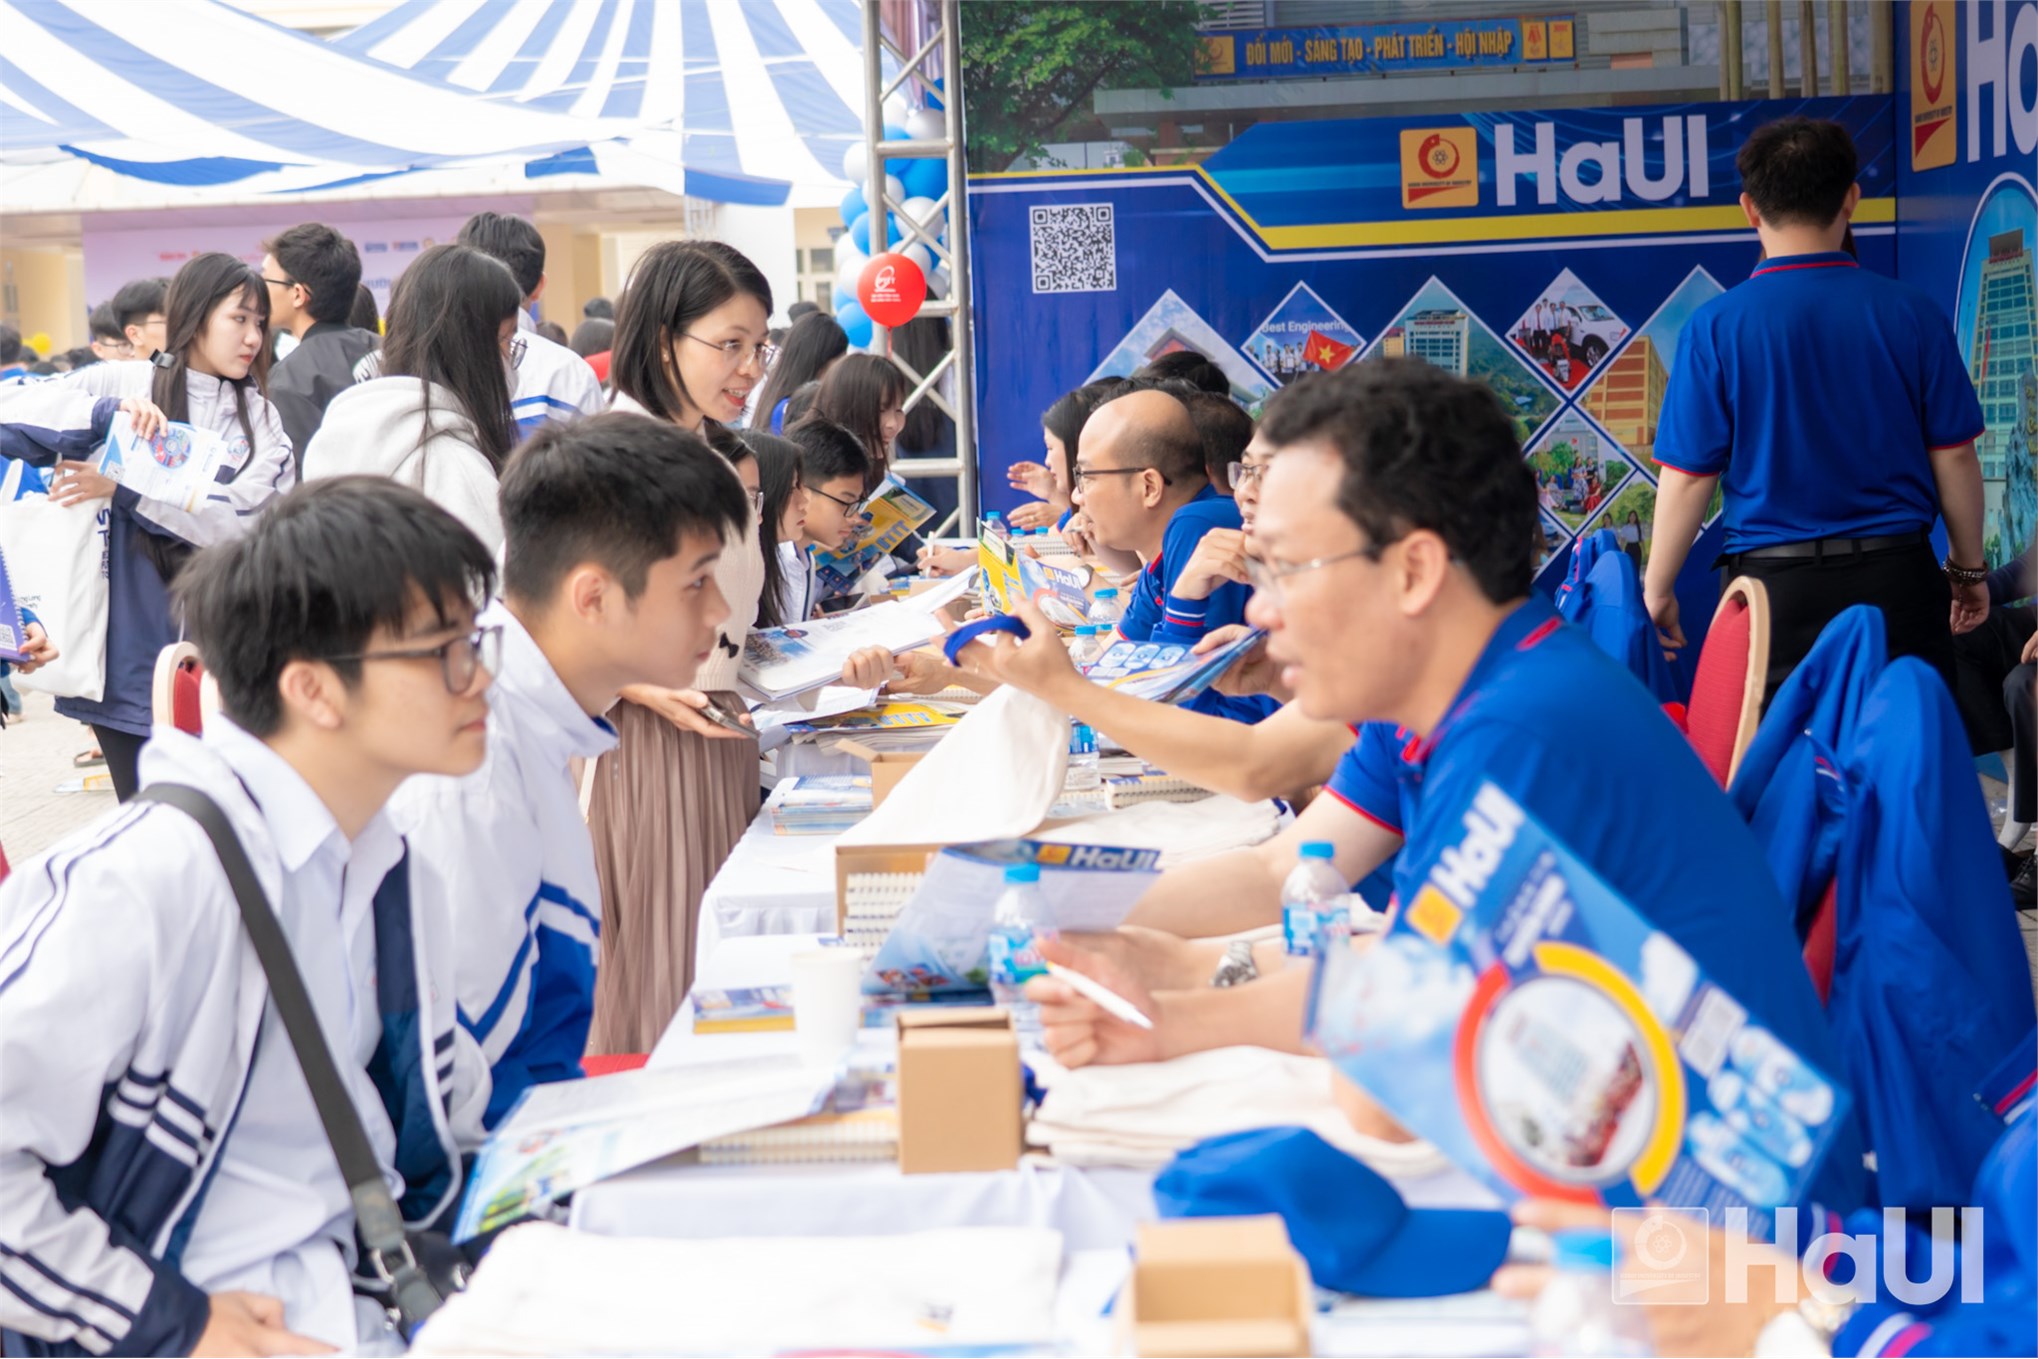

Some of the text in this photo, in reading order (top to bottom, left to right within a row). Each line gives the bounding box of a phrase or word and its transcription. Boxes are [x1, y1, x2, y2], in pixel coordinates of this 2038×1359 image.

[1270, 35, 1293, 64] MỚI
[1305, 34, 1338, 63] SÁNG
[1341, 37, 1363, 64] TẠO
[1374, 32, 1405, 60] PHÁT
[1455, 28, 1476, 59] HỘI
[1479, 27, 1512, 56] NHẬP
[1494, 114, 1709, 207] HaUI
[1070, 846, 1158, 870] HaUI
